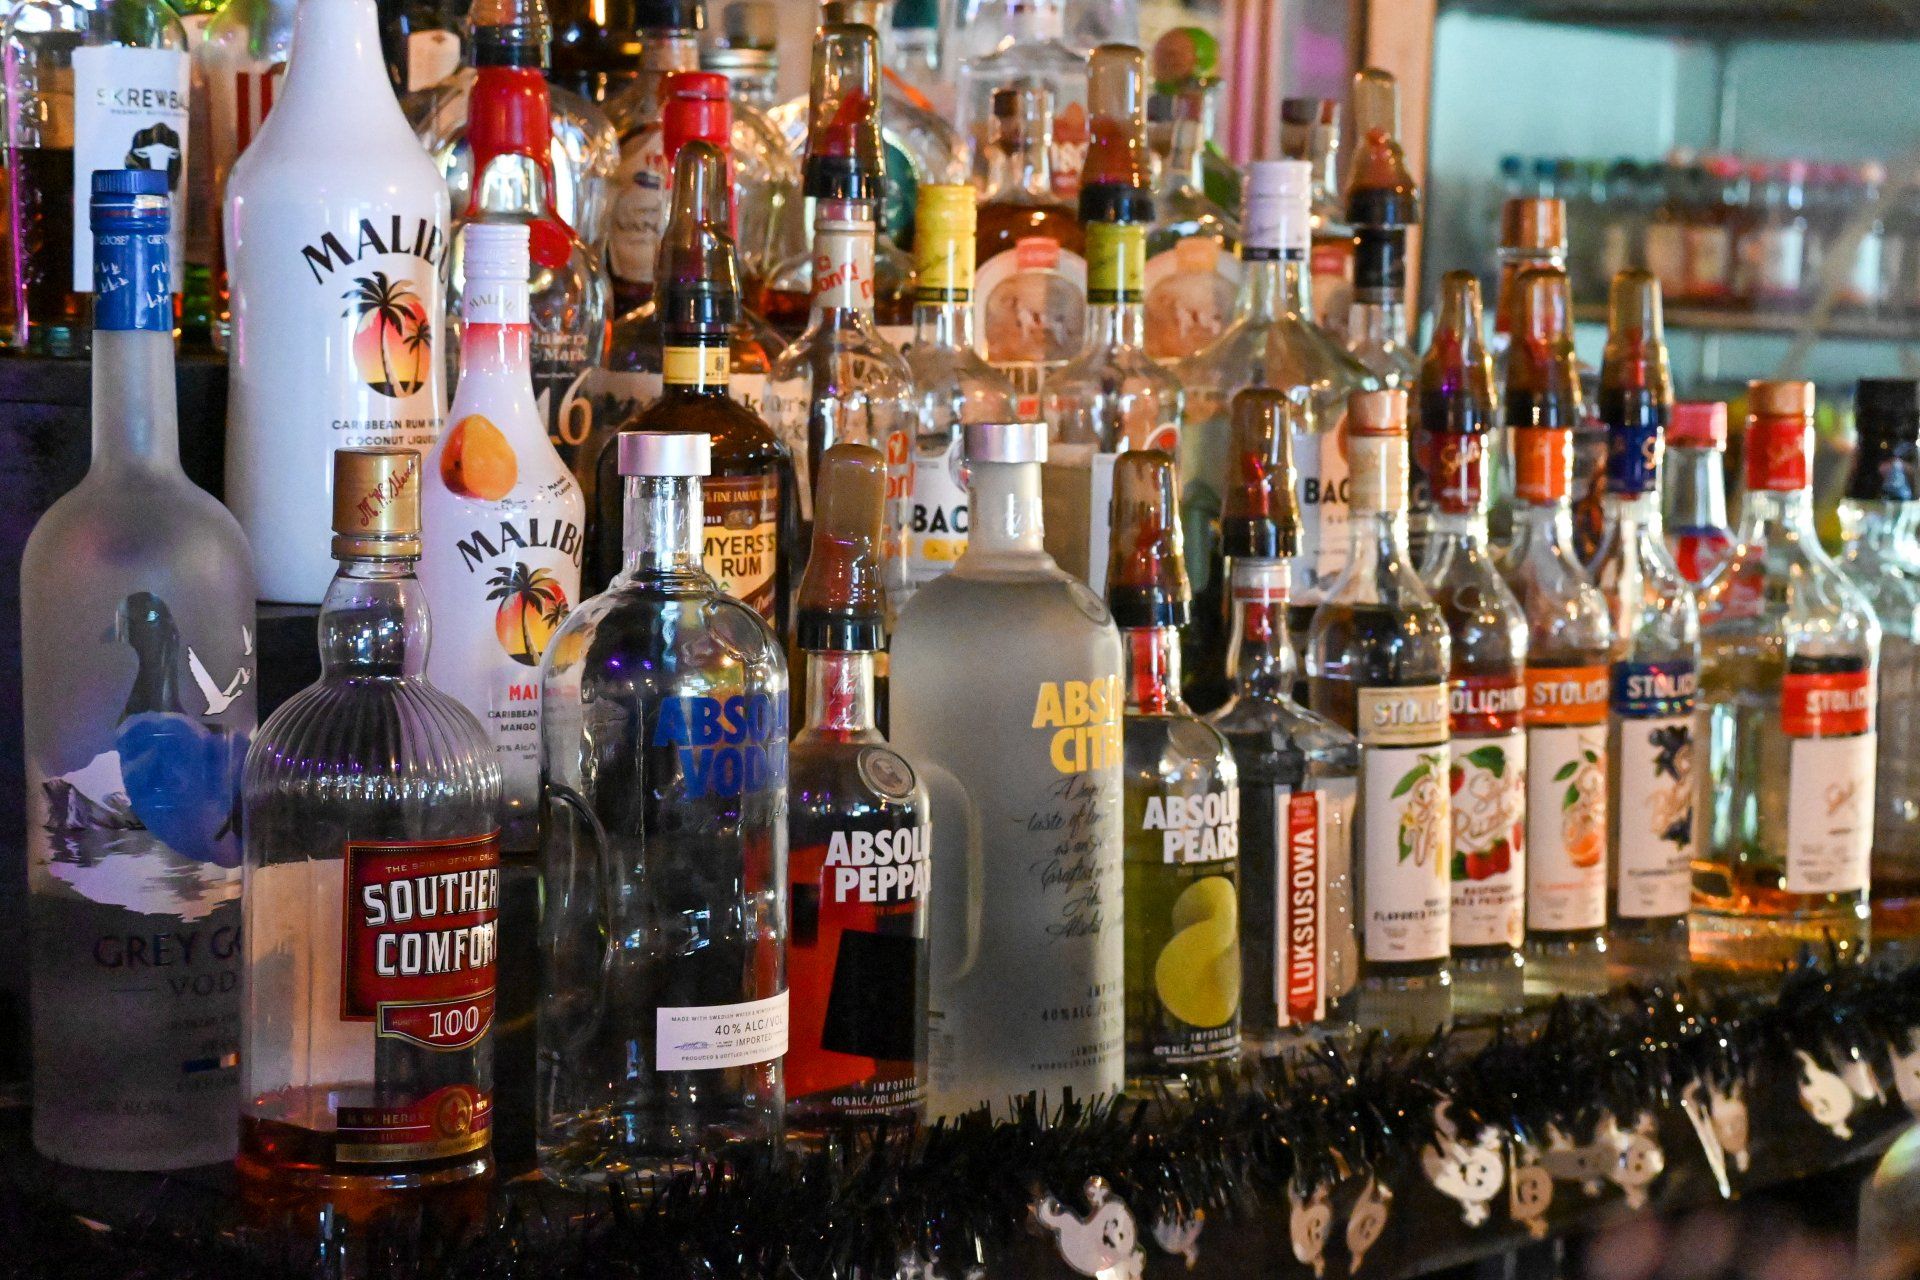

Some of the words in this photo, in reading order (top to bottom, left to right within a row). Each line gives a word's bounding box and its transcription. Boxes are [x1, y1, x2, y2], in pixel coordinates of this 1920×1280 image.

[301, 215, 449, 285] MALIBU
[332, 420, 401, 430] CARBBEAN
[406, 420, 425, 428] RUM
[1304, 478, 1349, 504] BAC
[913, 504, 968, 533] BAC
[457, 518, 582, 568] MALIBU
[722, 557, 762, 578] RUM
[1032, 677, 1121, 729] ABSO
[501, 722, 536, 732] MANGO
[680, 748, 770, 799] VOD
[385, 865, 408, 874] THE
[364, 868, 499, 926] SOUTHER
[1292, 828, 1314, 996] LUKSUSOWA
[93, 932, 197, 968] GREY
[428, 1005, 480, 1039] 100
[715, 1024, 741, 1036] 40%
[736, 1033, 772, 1047] IMPORTED
